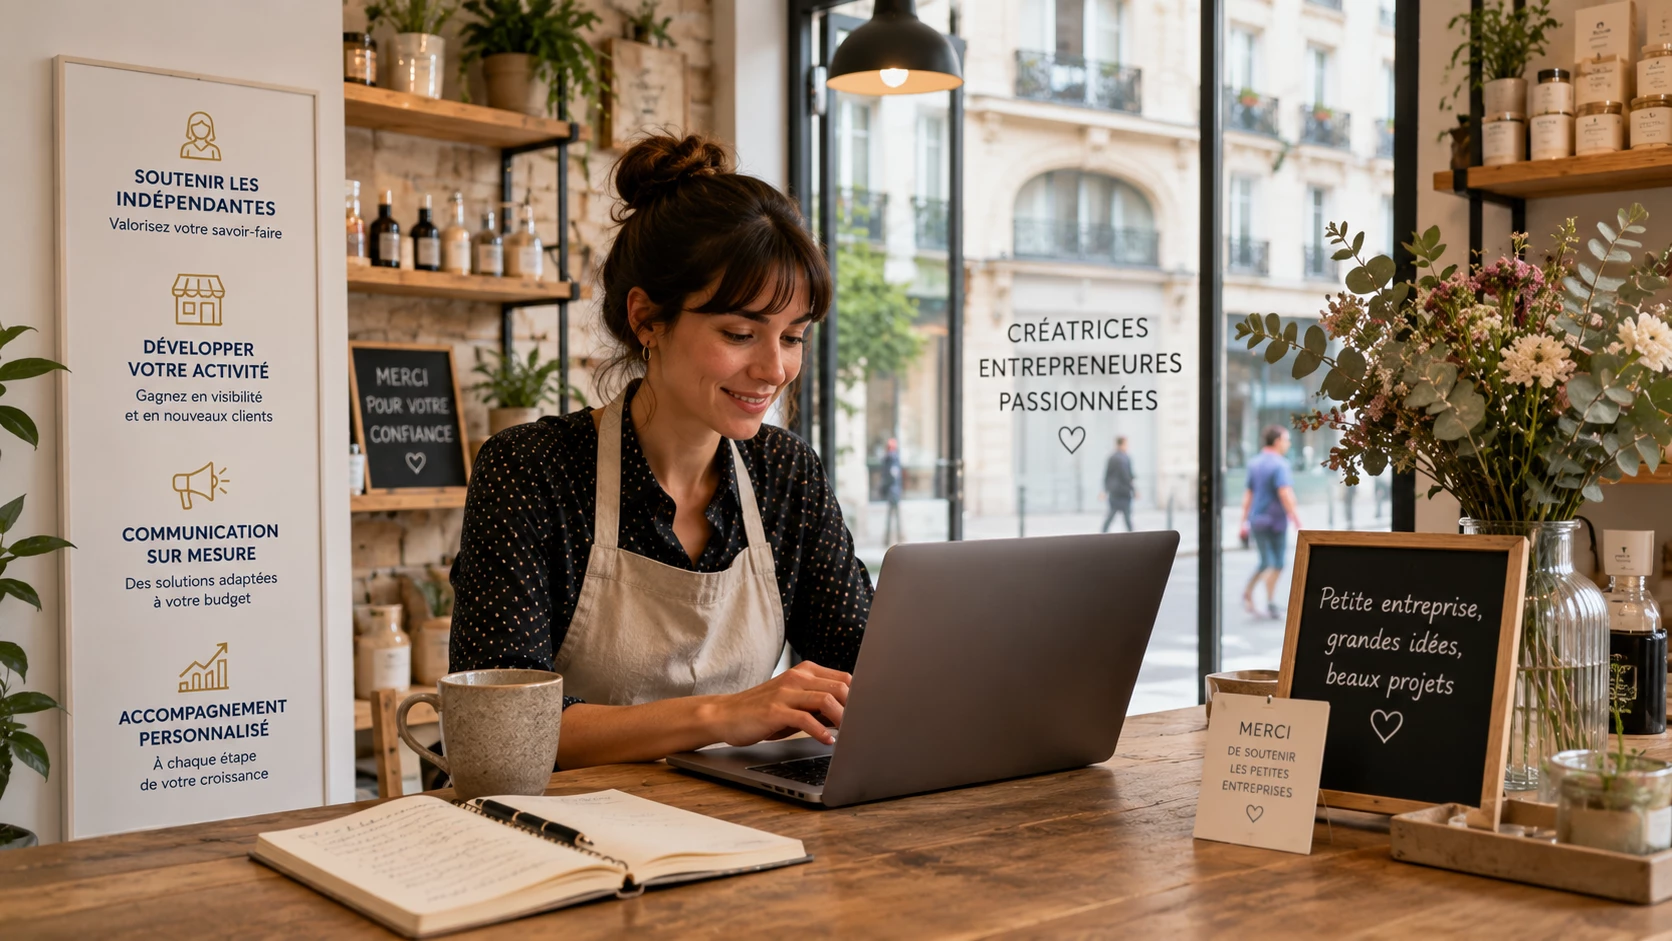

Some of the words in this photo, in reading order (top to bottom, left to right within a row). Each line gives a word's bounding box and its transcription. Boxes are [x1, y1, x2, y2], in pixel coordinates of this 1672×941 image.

[135, 168, 224, 190] SOUTENIR
[231, 177, 258, 192] LES
[117, 190, 275, 216] INDÉPENDANTES
[109, 217, 170, 232] Valorisez
[174, 224, 208, 234] votre
[213, 226, 282, 239] savoir-faire
[1008, 317, 1148, 343] CRÉATRICES
[144, 337, 254, 356] DÉVELOPPER
[128, 362, 187, 377] VOTRE
[193, 362, 268, 378] ACTIVITÉ
[980, 353, 1181, 377] ENTREPRENEURES
[376, 367, 429, 387] MERCI
[136, 389, 187, 405] Gagnez
[192, 393, 207, 402] en
[211, 391, 262, 403] visibilité
[366, 395, 403, 414] POUR
[406, 396, 449, 414] VOTRE
[1000, 385, 1157, 411] PASSIONNÉES
[125, 411, 138, 421] et
[143, 413, 159, 421] en
[164, 412, 228, 421] nouveaux
[232, 410, 272, 422] clients
[370, 425, 452, 443] CONFIANCE
[123, 524, 278, 541] COMMUNICATION
[148, 549, 181, 563] SUR
[188, 547, 256, 562] MESURE
[126, 578, 151, 589] Des
[156, 575, 214, 588] solutions
[219, 572, 277, 587] adaptées
[154, 596, 161, 608] à
[166, 596, 200, 607] votre
[205, 592, 251, 607] budget
[1320, 587, 1372, 611] Petite
[1382, 595, 1481, 624] entreprise,
[1325, 628, 1400, 655] grandes
[1410, 631, 1461, 658] idées,
[1326, 662, 1380, 688] beaux
[1386, 672, 1454, 701] projets
[119, 699, 287, 725] ACCOMPAGNEMENT
[139, 719, 269, 746] PERSONNALISÉ
[1240, 722, 1290, 739] MERCI
[153, 756, 163, 770] À
[168, 756, 216, 770] chaque
[221, 752, 257, 767] étape
[1228, 746, 1241, 756] DE
[1245, 748, 1295, 762] SOUTENIR
[141, 778, 157, 791] de
[162, 777, 196, 788] votre
[200, 769, 268, 785] croissance
[1230, 764, 1247, 774] LES
[1250, 766, 1289, 779] PETITES
[1222, 778, 1292, 798] ENTREPRISES
